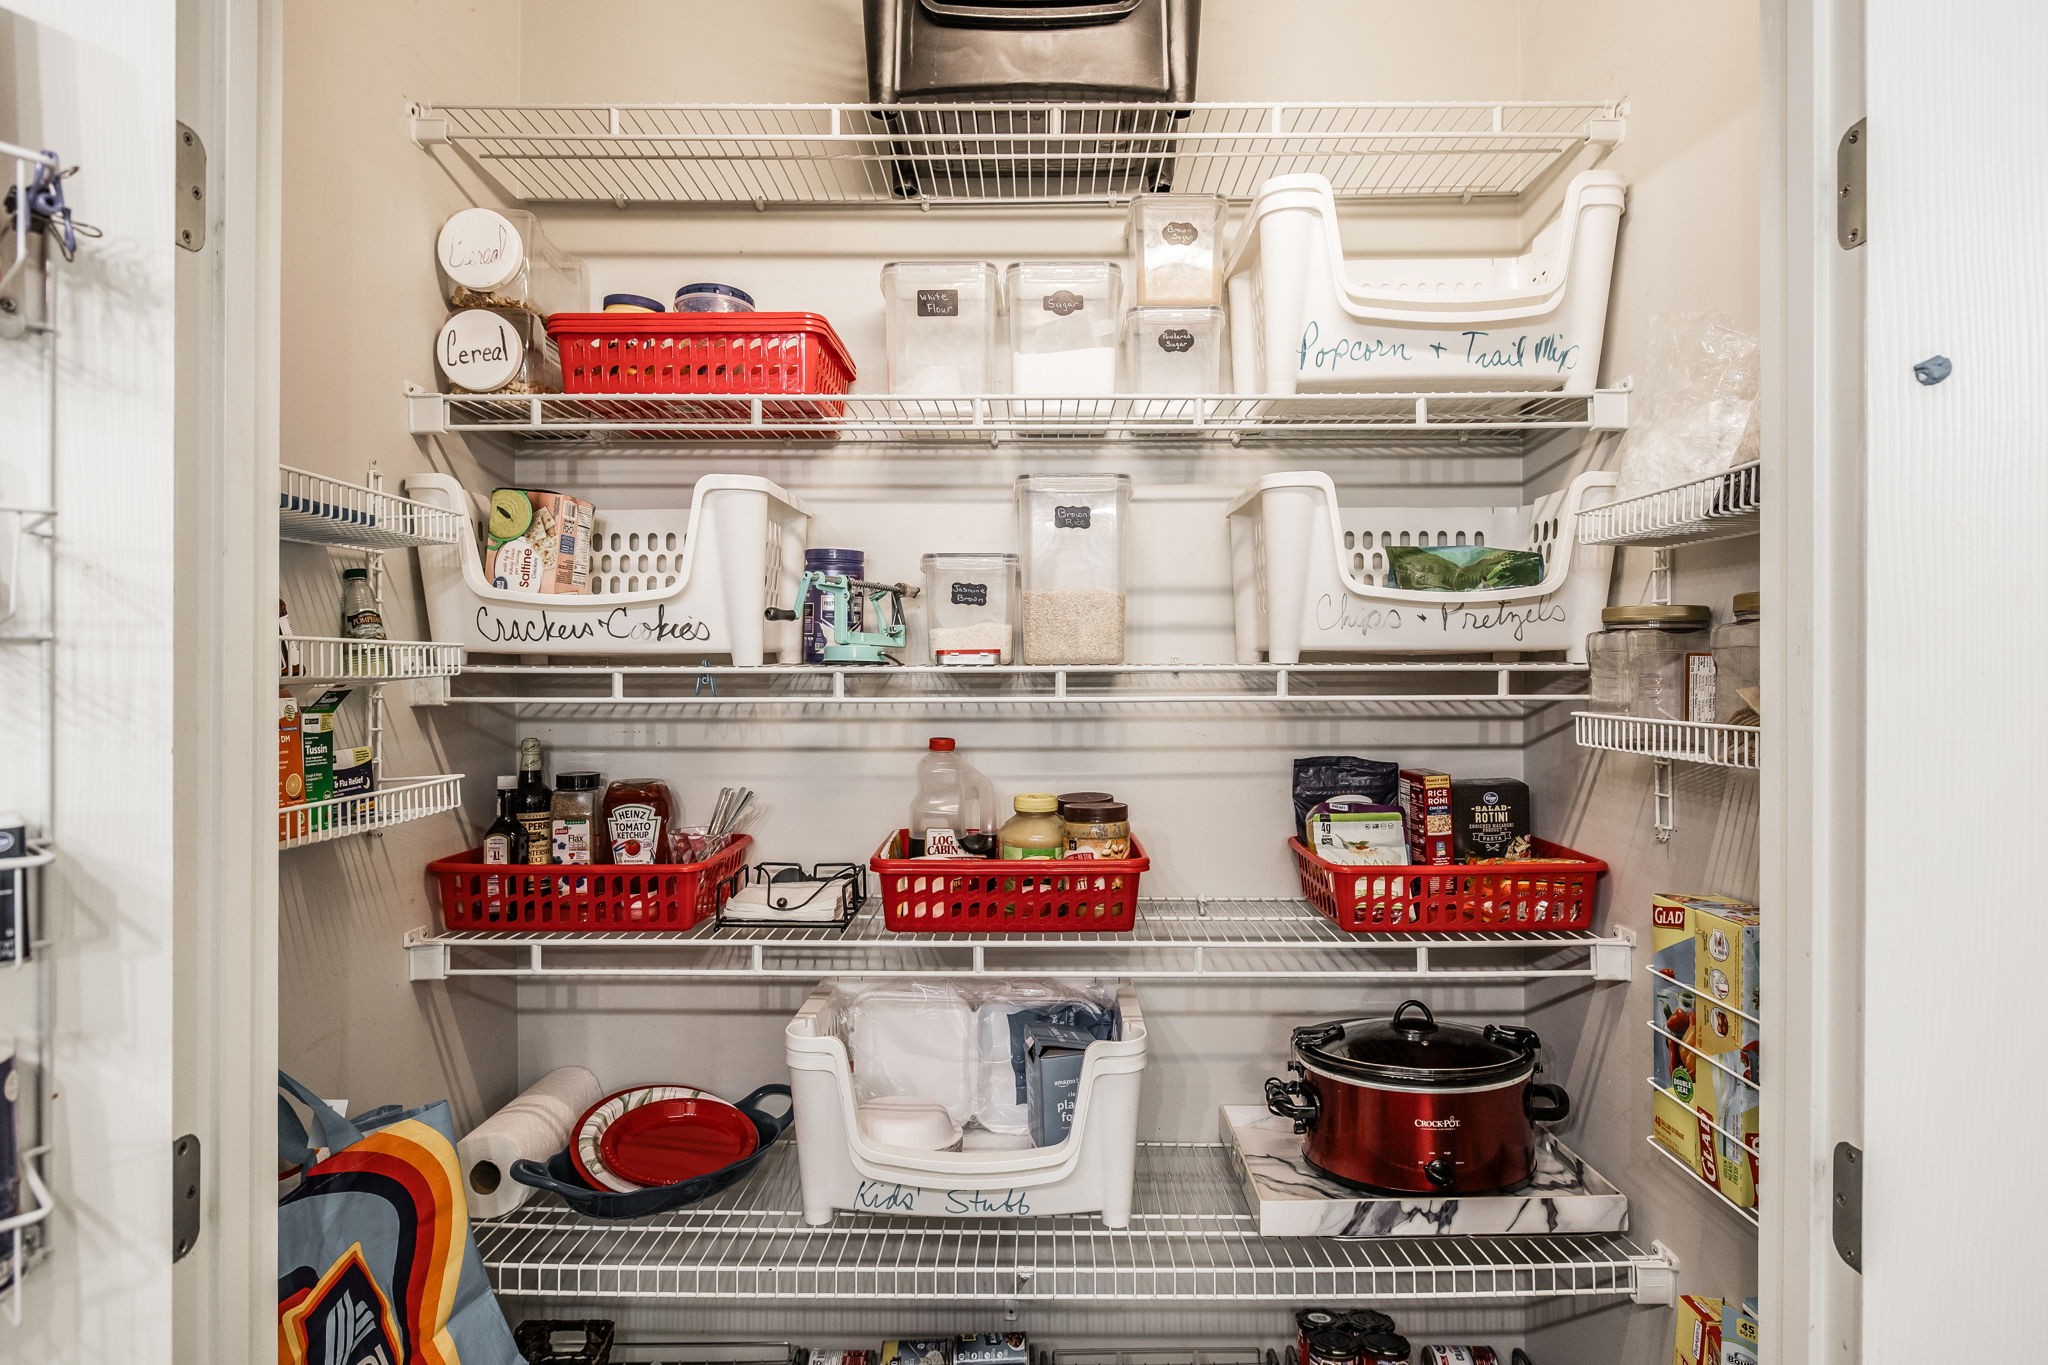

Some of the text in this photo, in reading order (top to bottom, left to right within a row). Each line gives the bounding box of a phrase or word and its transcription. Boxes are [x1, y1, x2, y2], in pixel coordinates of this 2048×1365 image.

[919, 292, 949, 302] White
[927, 303, 953, 315] Flour
[1047, 298, 1080, 311] Sugar
[446, 326, 509, 367] Cereal
[1165, 341, 1188, 349] Sugar
[1296, 320, 1413, 372] Popcorn
[1462, 330, 1527, 368] Trail
[1534, 334, 1580, 374] Mix
[1057, 508, 1089, 520] Brown
[1065, 518, 1086, 527] Rice
[519, 548, 532, 588] Saltine
[952, 585, 986, 595] Jasmine
[956, 594, 985, 605] Brown
[476, 606, 594, 642] Crackers
[607, 603, 711, 642] Cookies
[1442, 593, 1567, 642] Pretzels
[280, 735, 291, 743] DM
[304, 743, 328, 755] Tussin
[339, 779, 348, 787] Flu
[348, 776, 364, 786] Relief
[1427, 789, 1448, 797] RICE
[1428, 797, 1448, 805] RONI
[618, 810, 647, 820] HEINZ
[1475, 812, 1508, 823] ROTINI
[615, 822, 651, 832] TOMATO
[1320, 822, 1331, 834] 4g
[568, 834, 583, 842] Flax
[616, 831, 649, 840] KETCHUP
[932, 835, 954, 846] LOG
[927, 845, 959, 856] CABIN
[1654, 907, 1684, 925] GLAD
[1054, 1079, 1075, 1088] amazon
[1673, 1078, 1692, 1089] DOUBLE
[1676, 1086, 1689, 1095] SEAL
[1057, 1099, 1075, 1112] pla
[1700, 1112, 1717, 1182] GLAD
[1741, 1322, 1755, 1335] 45
